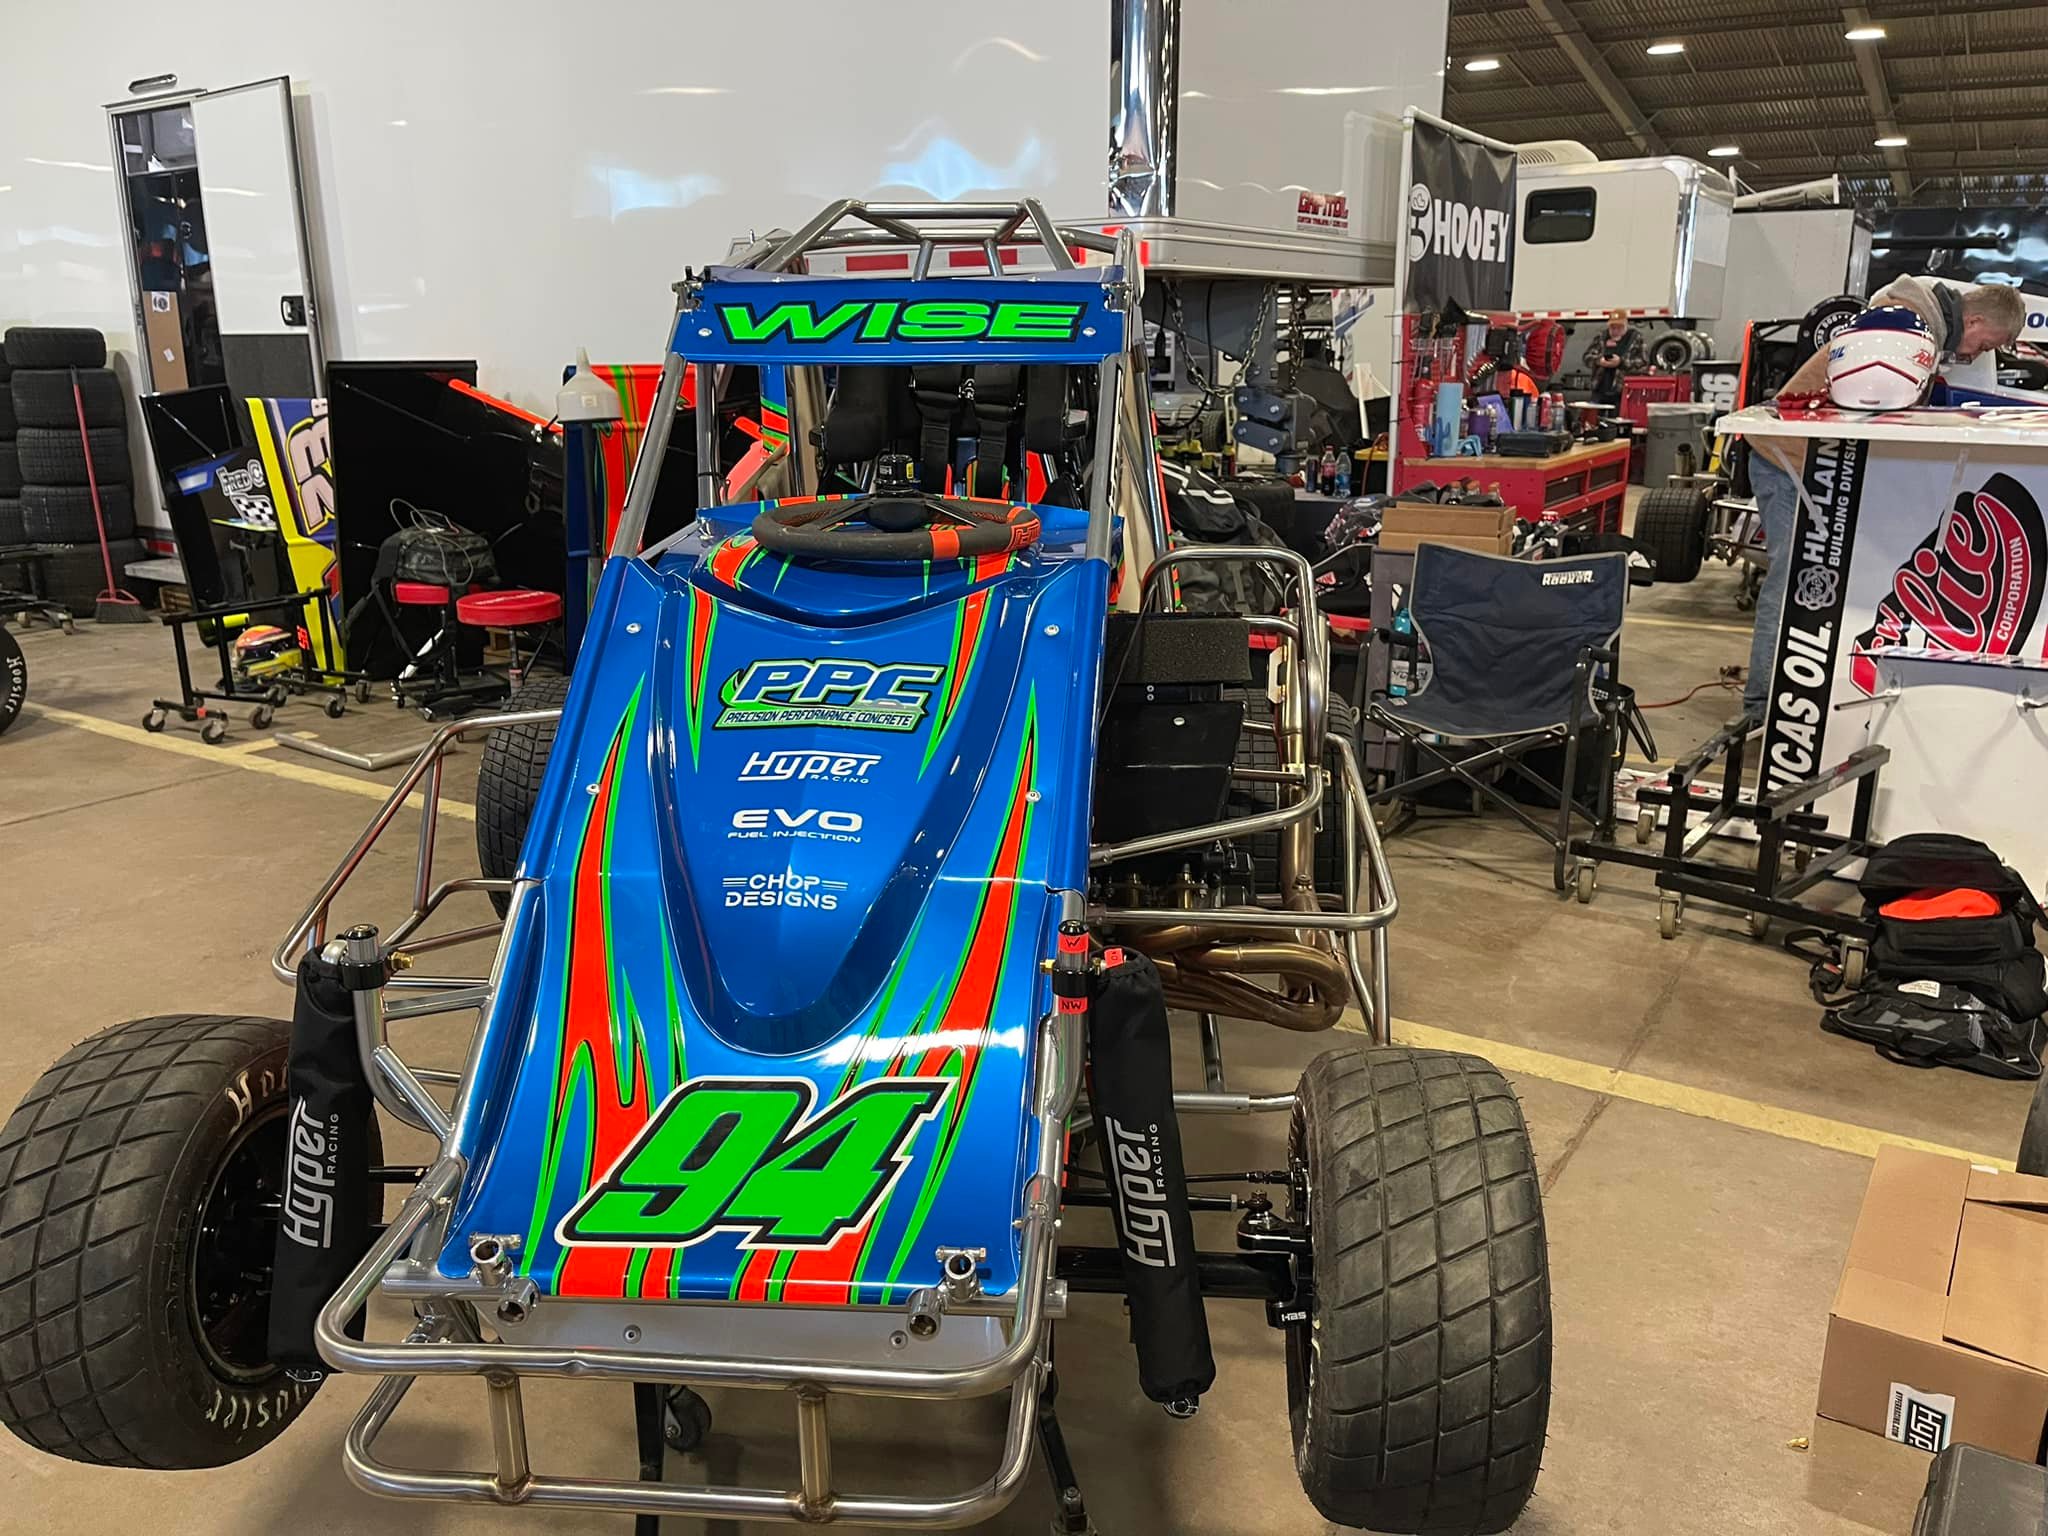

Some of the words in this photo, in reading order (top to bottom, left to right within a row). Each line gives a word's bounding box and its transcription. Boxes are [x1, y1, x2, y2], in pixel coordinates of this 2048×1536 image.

[1433, 198, 1511, 263] HOOEY
[715, 301, 1088, 343] WISE
[1829, 495, 1849, 567] BUILDING
[1997, 535, 2024, 641] CORPORATION
[731, 659, 945, 708] PPC
[724, 710, 779, 724] PRECISION
[779, 709, 854, 724] PERFORMANCE
[855, 712, 913, 726] CONCRETE
[737, 750, 882, 782] Hyper
[810, 774, 869, 784] RACING
[727, 831, 768, 839] FUEL
[772, 831, 861, 843] INJECTION
[732, 808, 863, 832] EVO
[749, 866, 821, 891] CHOP
[725, 891, 838, 910] DESIGNS
[1066, 936, 1081, 948] W
[1062, 1000, 1082, 1010] NW
[327, 1113, 340, 1174] RACING
[555, 1075, 958, 1250] 94
[1150, 1123, 1165, 1187] RACING
[283, 1096, 336, 1249] Hyper
[1105, 1116, 1176, 1267] Hyper
